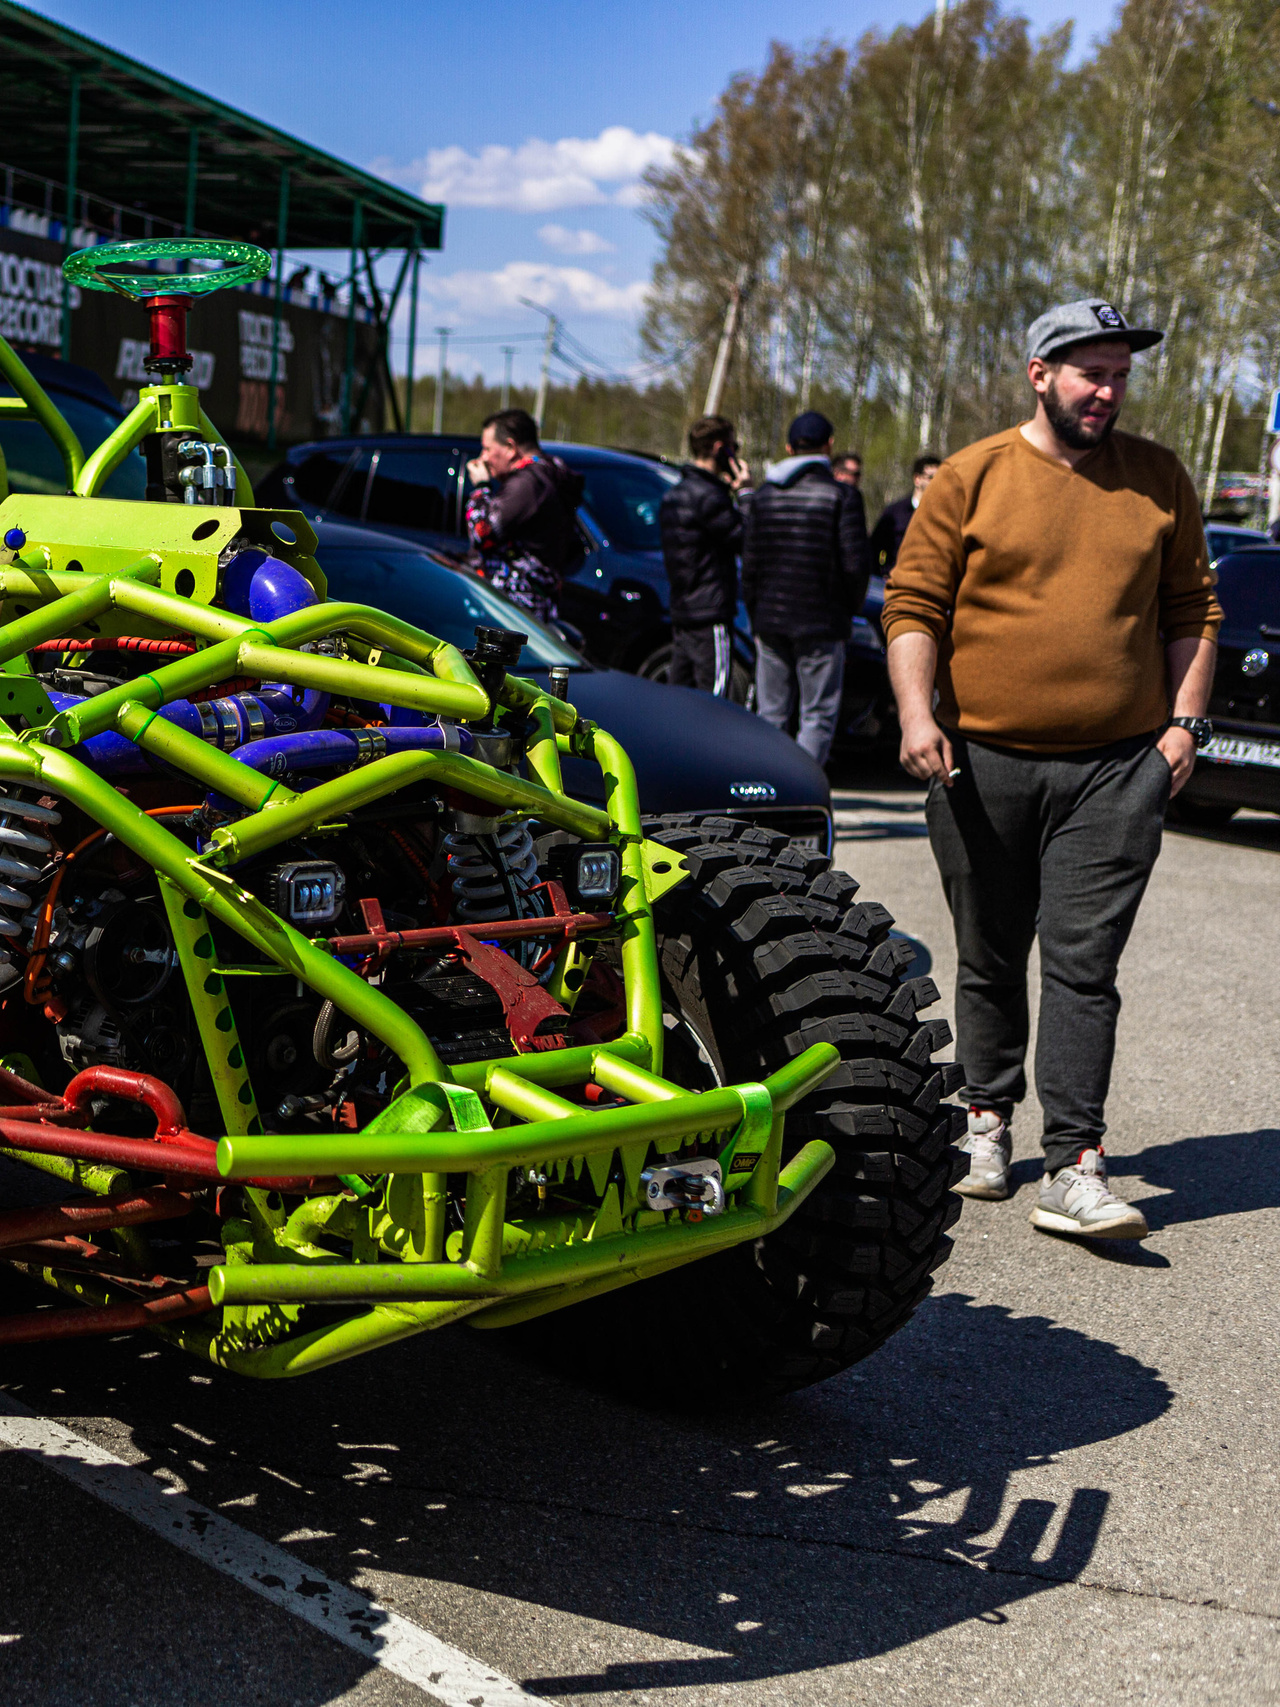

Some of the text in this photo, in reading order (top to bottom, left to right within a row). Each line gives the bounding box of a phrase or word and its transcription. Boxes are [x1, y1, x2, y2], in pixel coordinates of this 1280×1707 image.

[115, 338, 216, 391] RERD
[533, 1033, 567, 1052] WOLF
[733, 1158, 756, 1168] OMP
